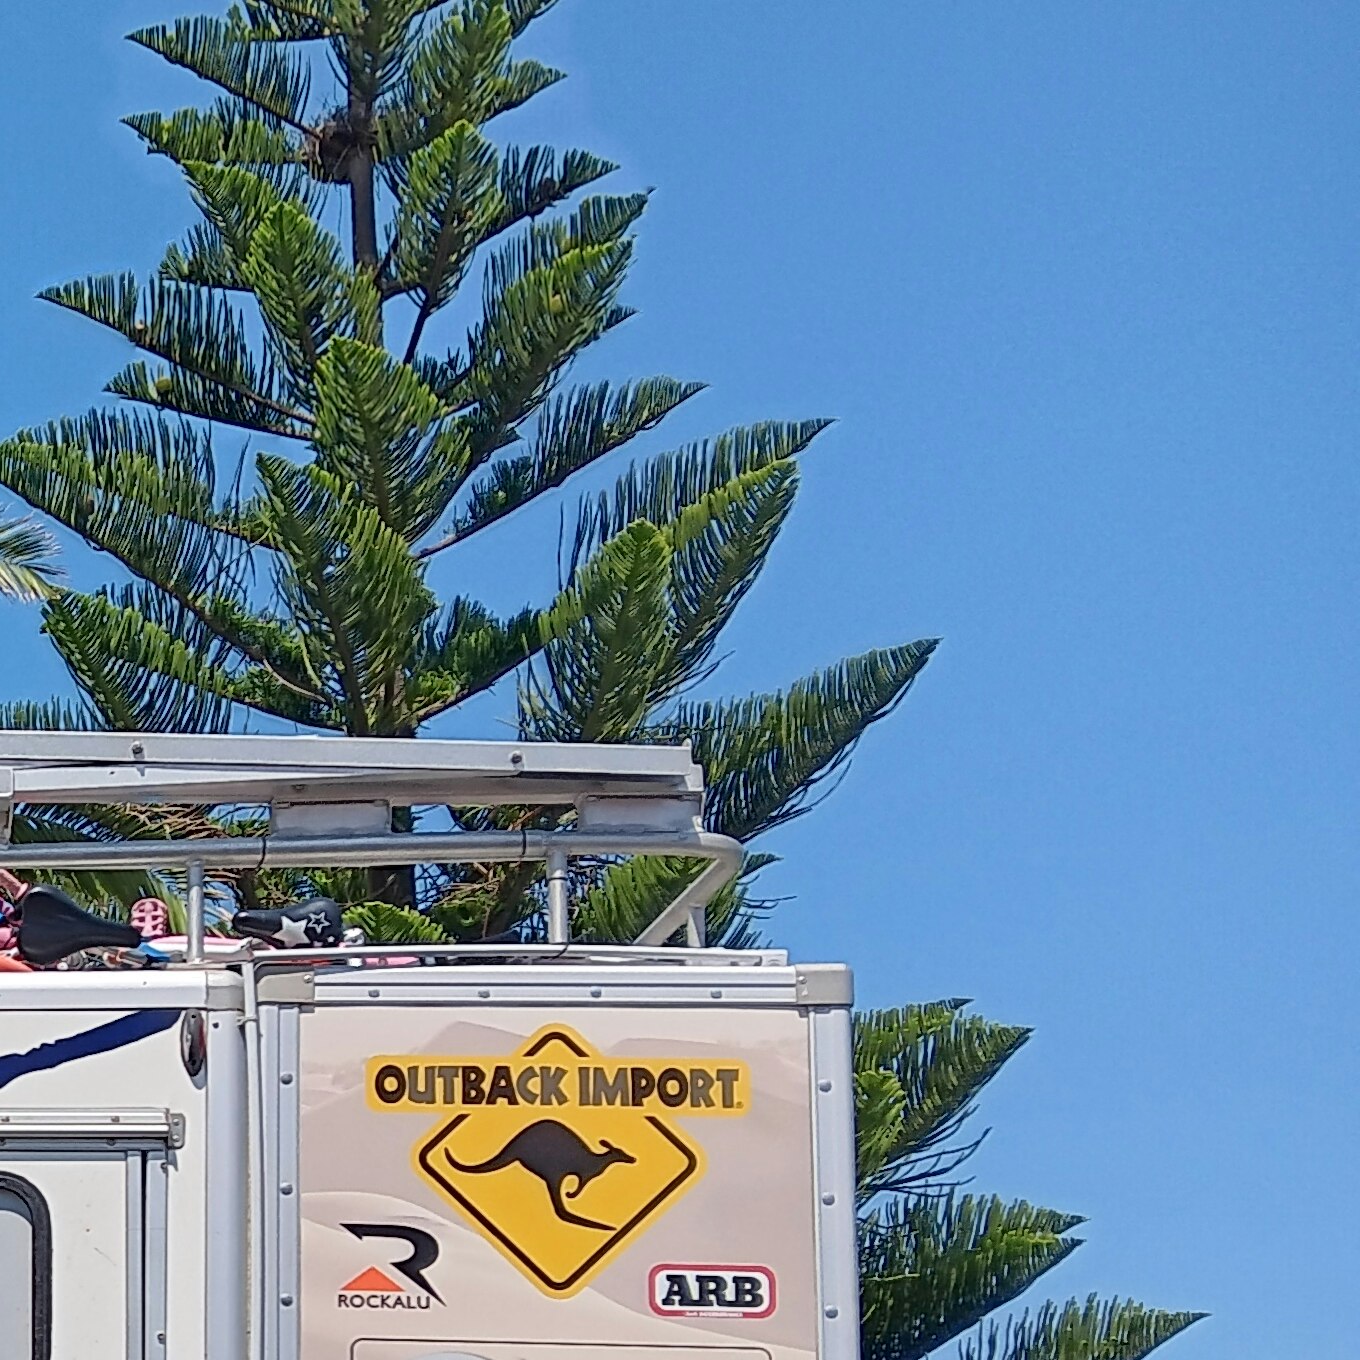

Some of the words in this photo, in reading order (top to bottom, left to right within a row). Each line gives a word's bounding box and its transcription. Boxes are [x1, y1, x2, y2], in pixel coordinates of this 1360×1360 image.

[374, 1064, 569, 1107] OUTBACK
[579, 1066, 740, 1109] IMPORT
[338, 1293, 431, 1310] ROCKALU
[662, 1274, 764, 1307] ARB
